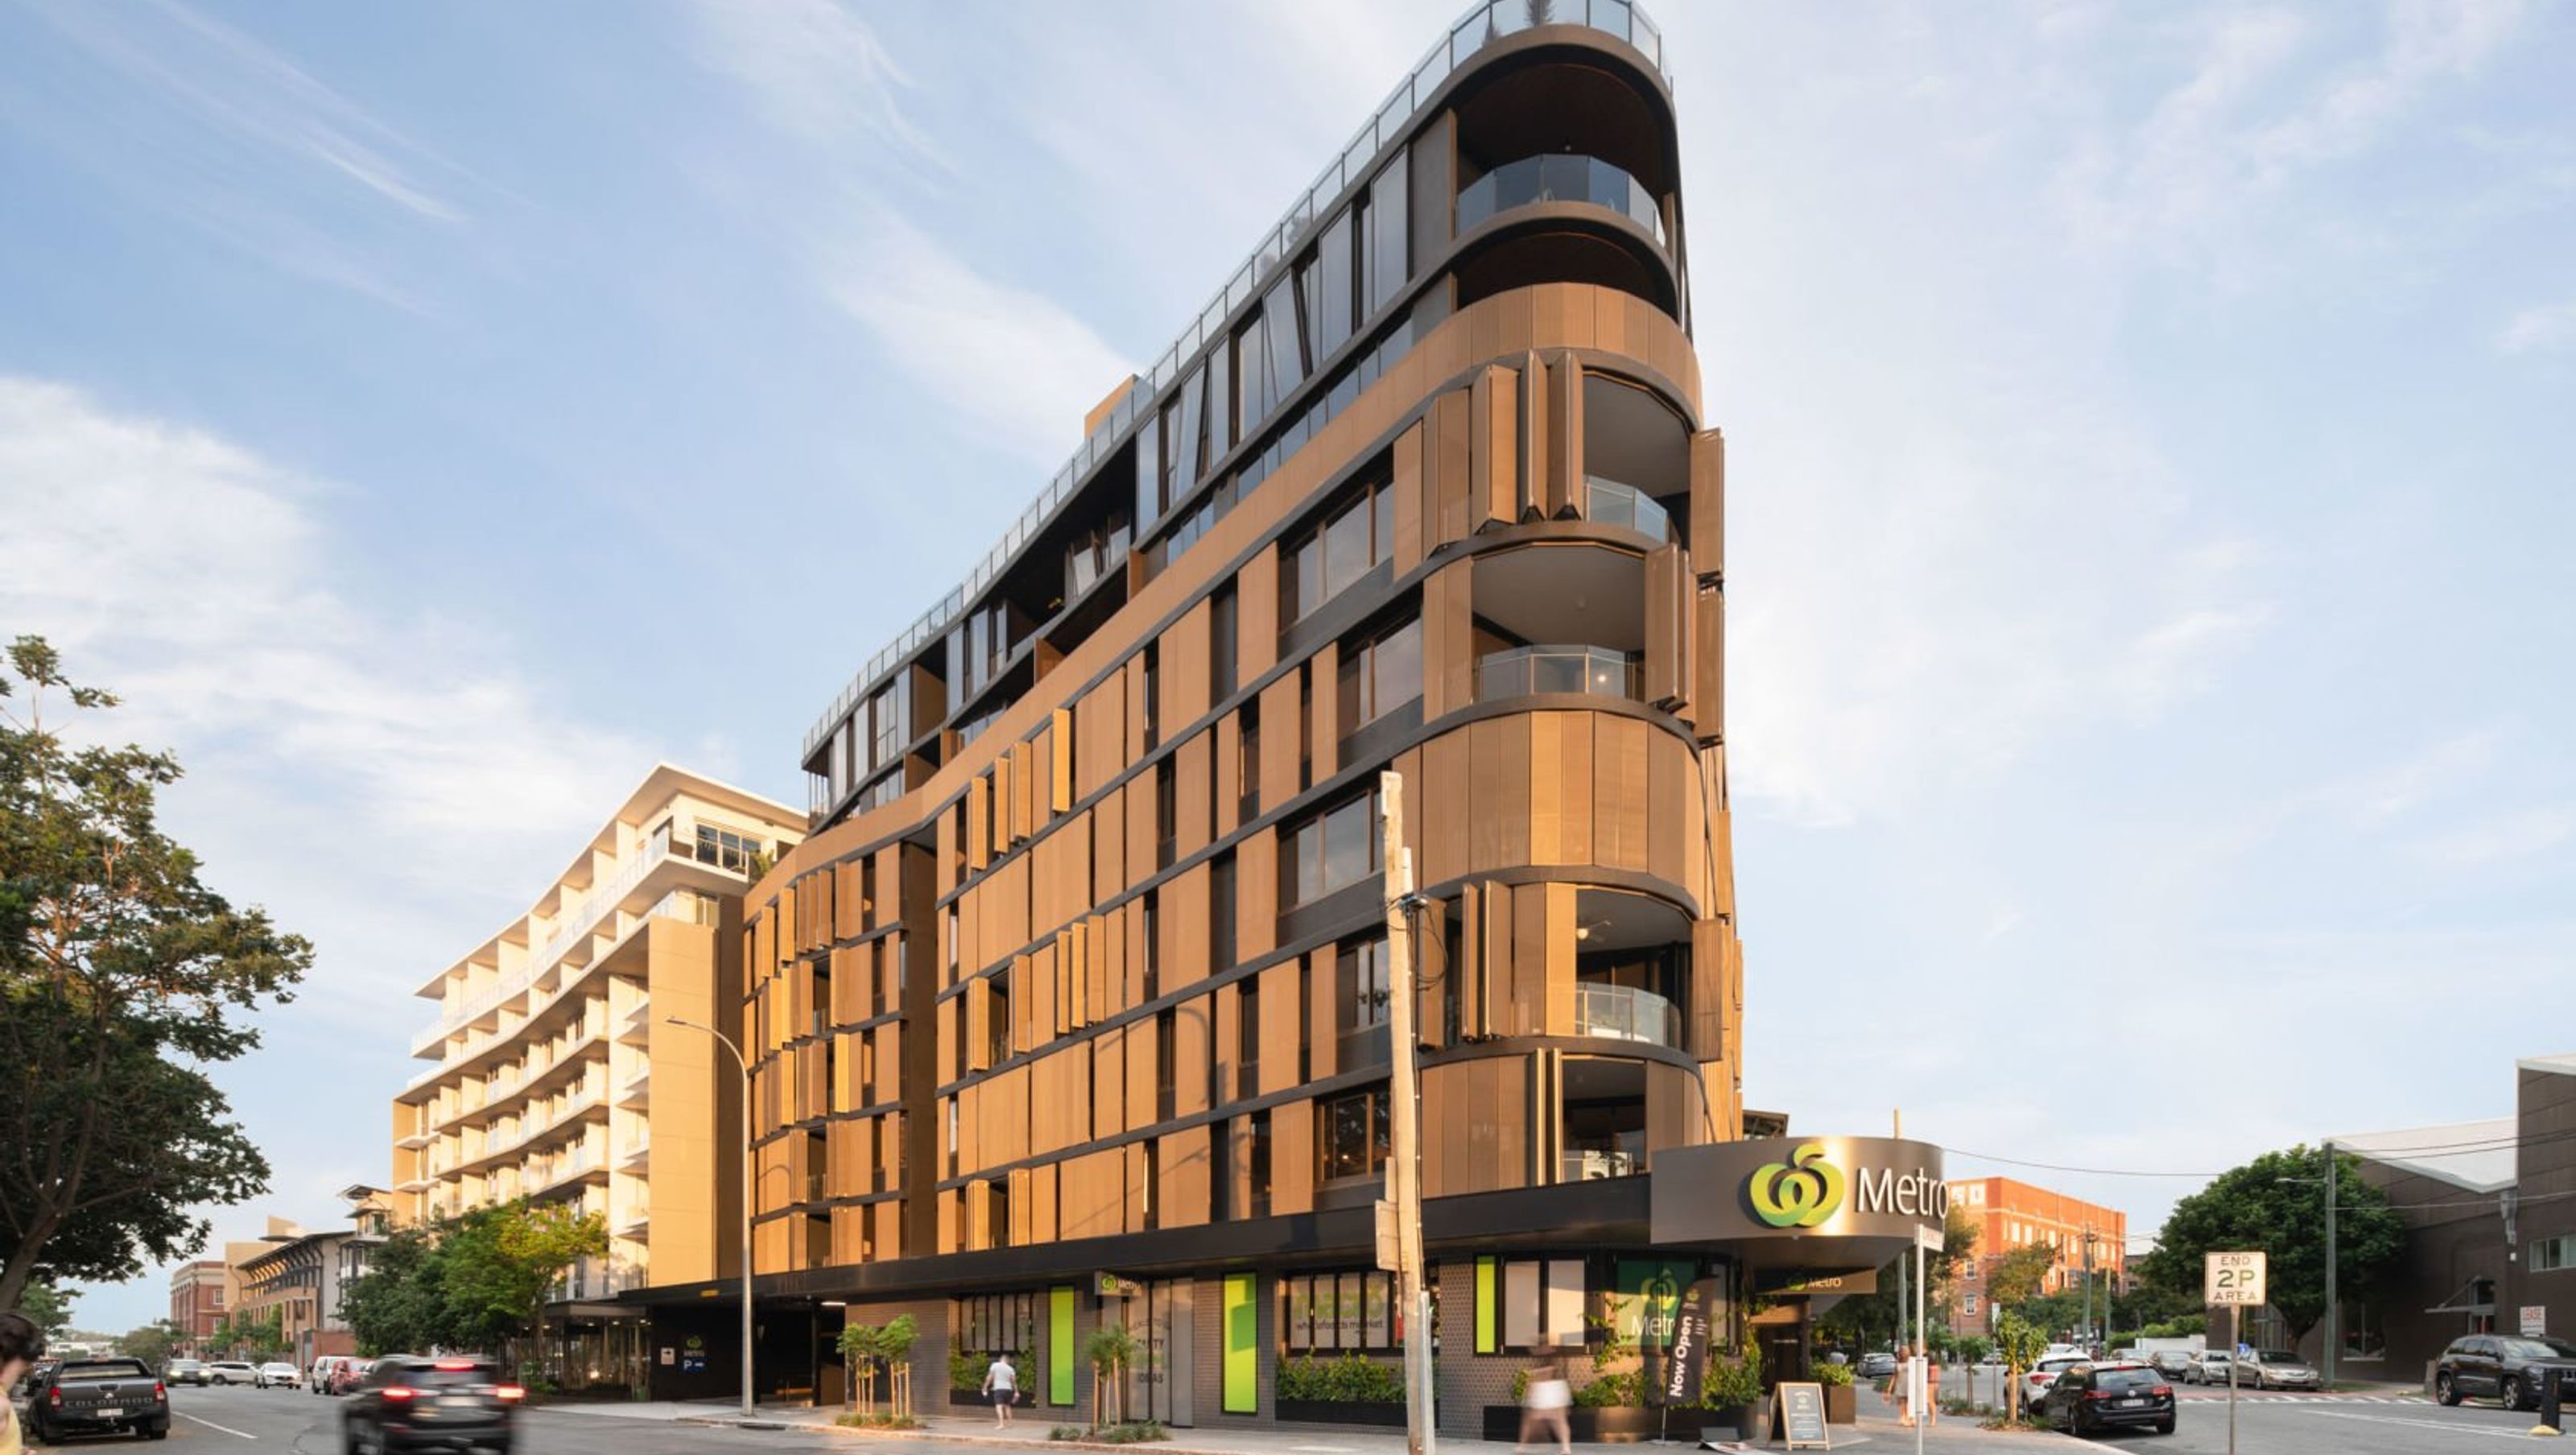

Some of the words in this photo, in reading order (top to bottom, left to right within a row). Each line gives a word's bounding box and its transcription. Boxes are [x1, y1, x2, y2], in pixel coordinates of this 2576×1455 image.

[1858, 1167, 1949, 1219] Metro
[2220, 1256, 2251, 1266] END
[2217, 1269, 2256, 1288] 2P
[2214, 1291, 2257, 1300] AREA
[1632, 1313, 1674, 1336] Metr
[1674, 1316, 1694, 1359] Open
[1670, 1361, 1686, 1397] Now
